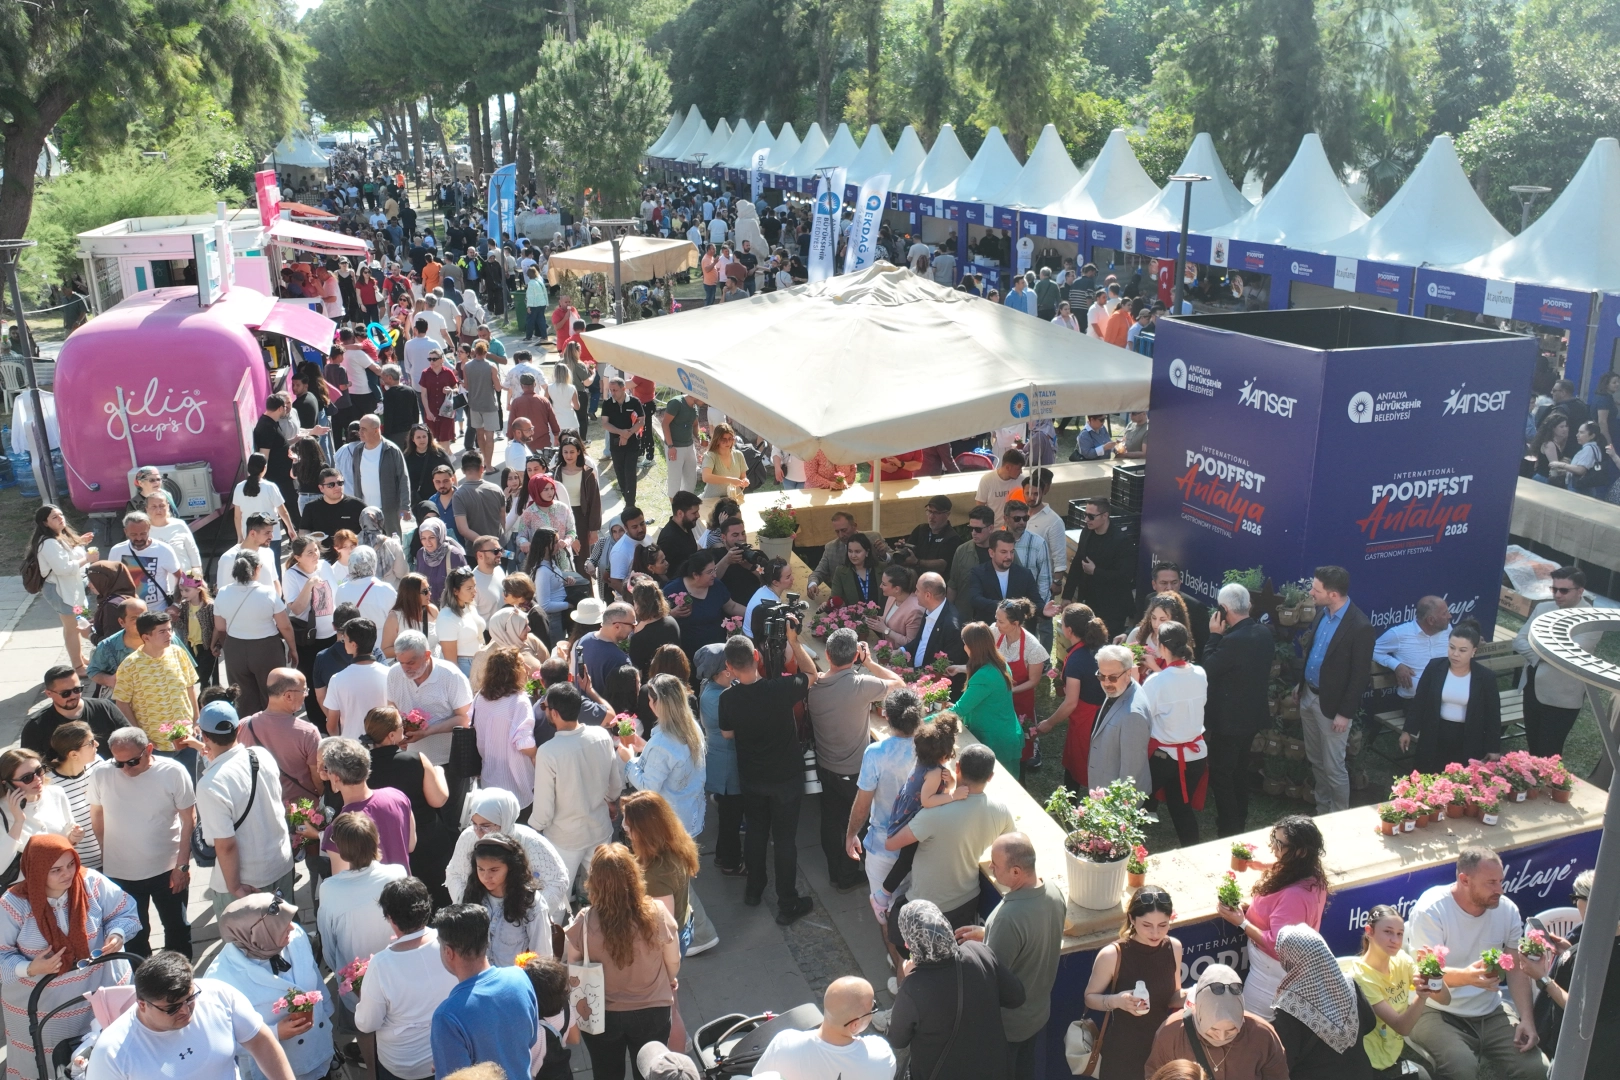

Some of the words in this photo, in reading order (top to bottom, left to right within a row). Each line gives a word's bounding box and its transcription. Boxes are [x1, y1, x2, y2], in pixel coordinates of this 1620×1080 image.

[858, 212, 874, 253] EKDAĞ
[1188, 364, 1212, 376] ANTALYA
[1187, 383, 1214, 397] BELEDİYESİ
[1188, 373, 1222, 390] BÜYÜKŞEHİR
[1376, 391, 1408, 401] ANTALYA
[1375, 398, 1422, 412] BÜYÜKŞEHİR
[1374, 409, 1411, 423] BELEDİYESİ
[1201, 445, 1250, 467] INTERNATIONAL
[1185, 449, 1266, 493] FOODFEST
[1393, 467, 1456, 480] INTERNATIONAL
[1175, 463, 1265, 532] Antalya
[1371, 475, 1474, 505] FOODFEST
[1180, 512, 1211, 530] GASTRONOMY
[1211, 525, 1233, 538] FESTIVAL
[1355, 493, 1473, 544] Antalya
[1241, 519, 1262, 536] 2026
[1444, 522, 1468, 536] 2026
[1364, 549, 1406, 561] GASTRONOMY
[1406, 546, 1433, 555] FESTIVAL
[1185, 569, 1209, 595] başka
[1370, 606, 1402, 629] başka
